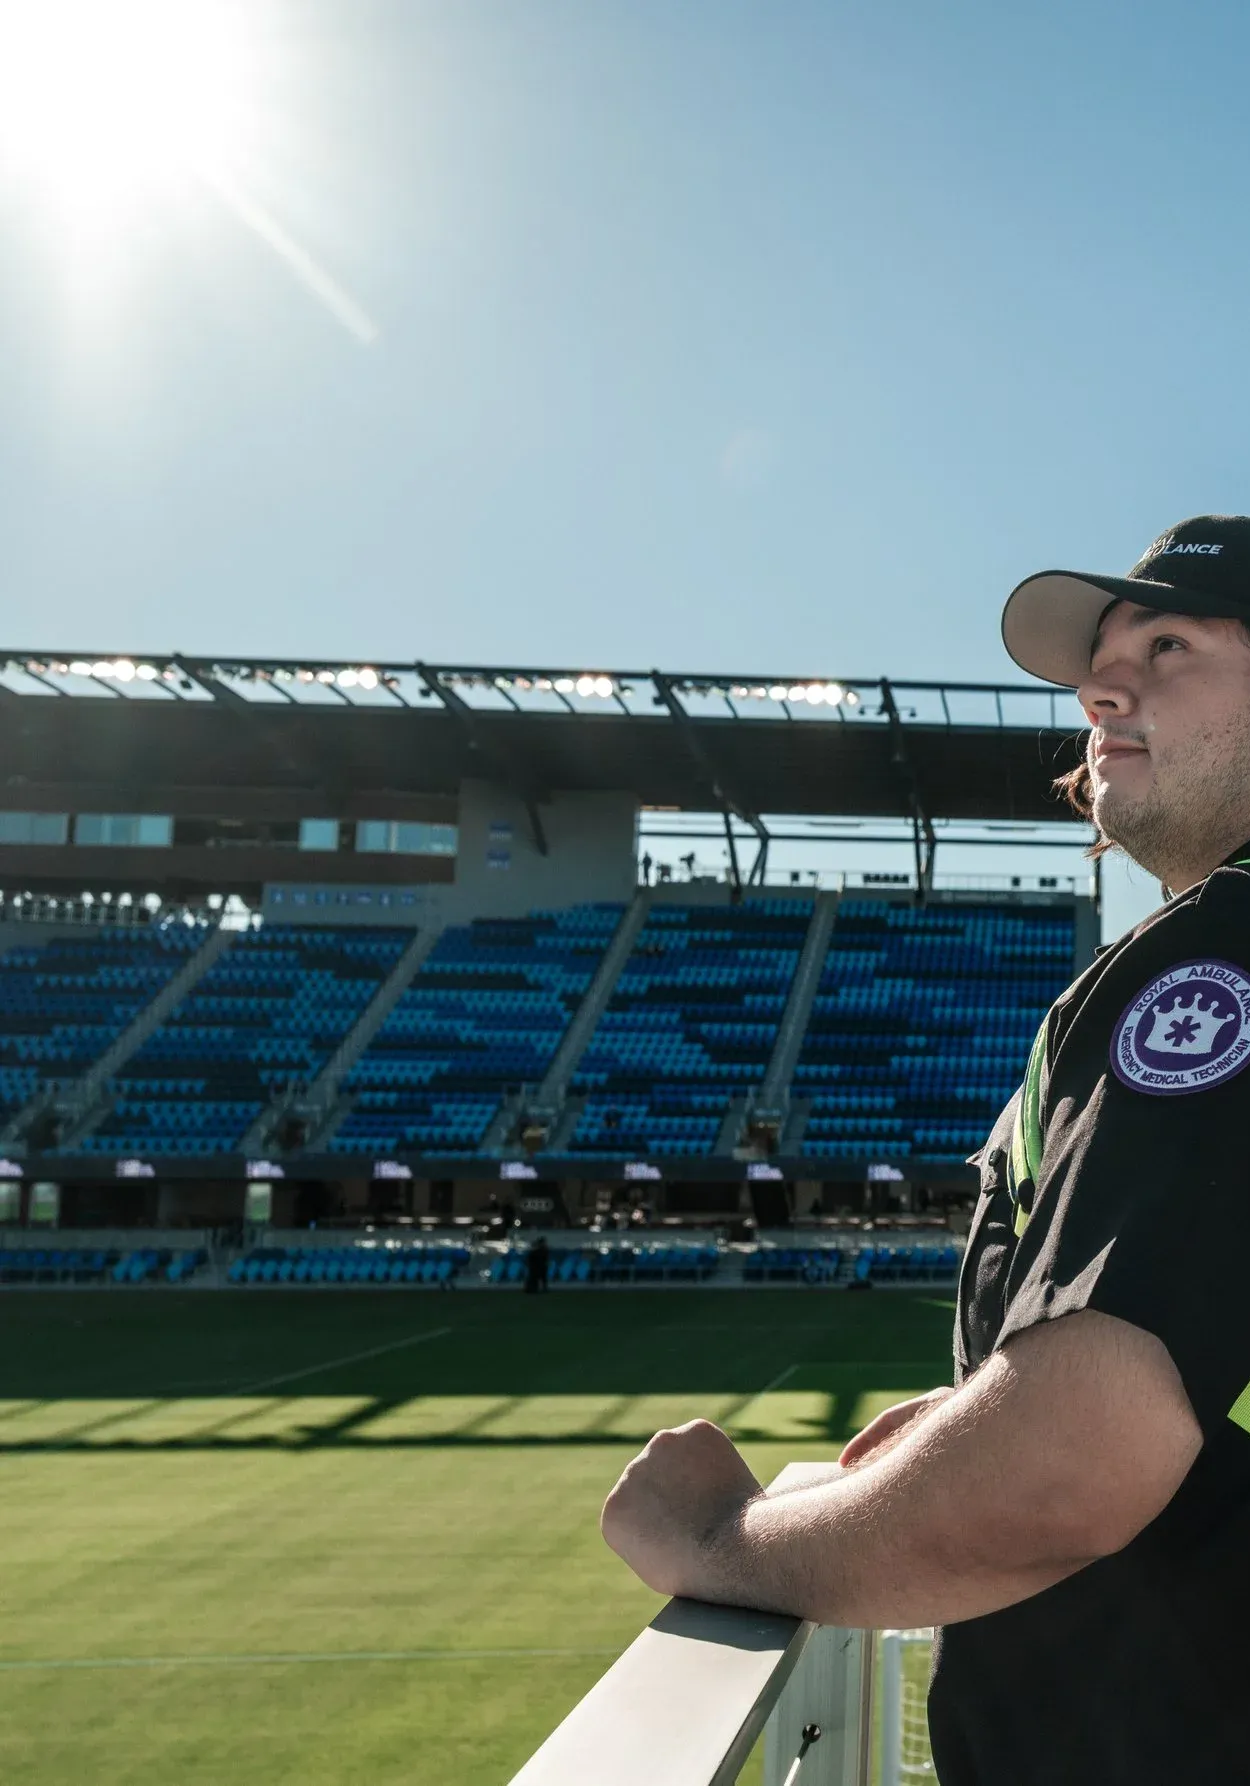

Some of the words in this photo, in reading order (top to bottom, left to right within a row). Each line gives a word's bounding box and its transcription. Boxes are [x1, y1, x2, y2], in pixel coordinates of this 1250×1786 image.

[1146, 543, 1224, 557] ULANCE
[1134, 974, 1180, 1015] ROYAL
[1121, 1025, 1144, 1076] EMERGENCY
[1140, 1069, 1189, 1085] MEDICAL
[1190, 1038, 1250, 1081] TECHNICIAN
